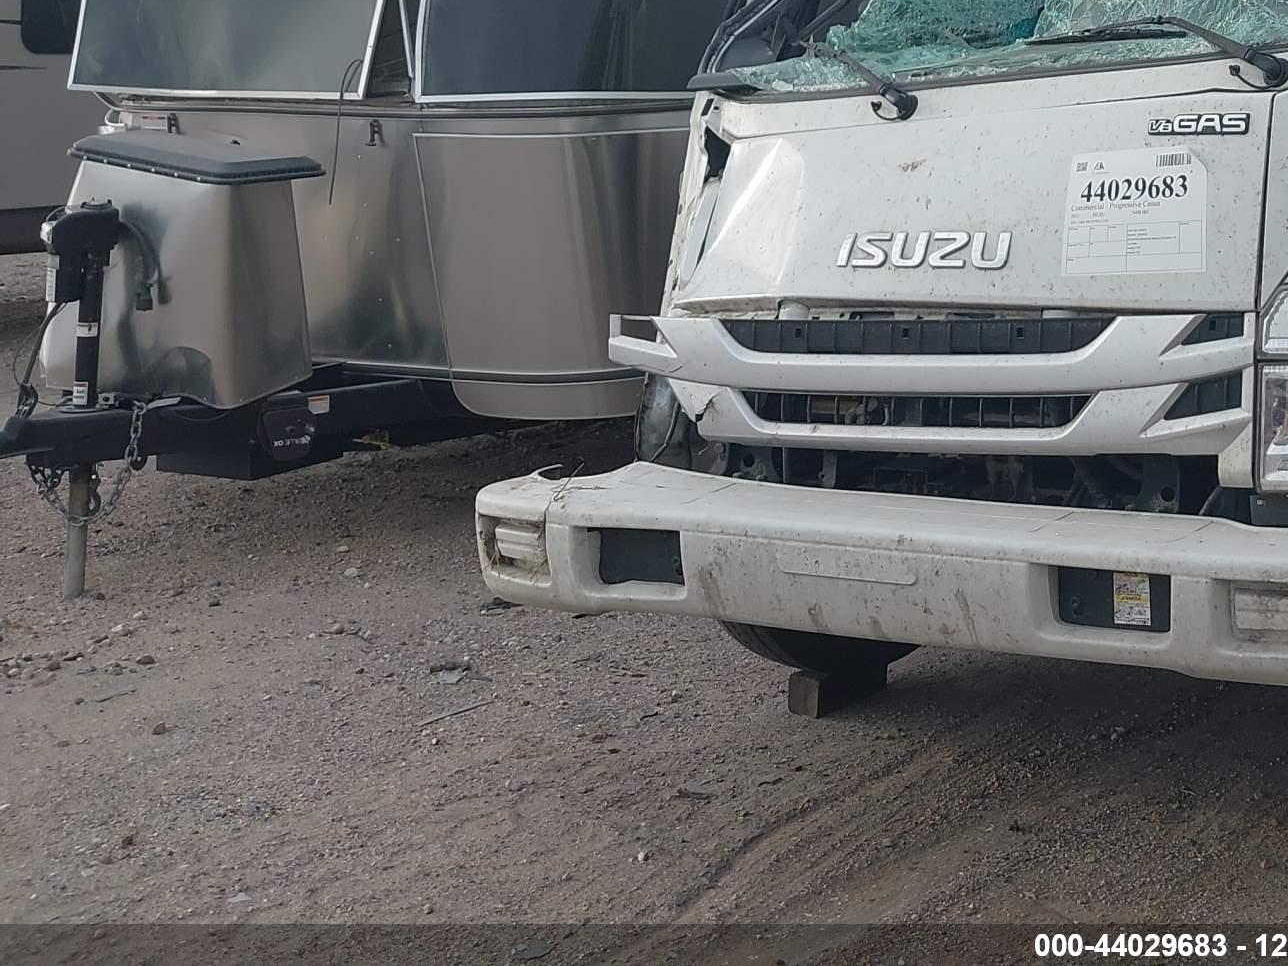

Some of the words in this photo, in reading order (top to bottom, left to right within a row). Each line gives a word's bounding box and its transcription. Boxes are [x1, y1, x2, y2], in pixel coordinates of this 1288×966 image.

[1173, 114, 1247, 132] GAS
[1080, 175, 1188, 202] 44029683
[836, 231, 1012, 270] ISUZU
